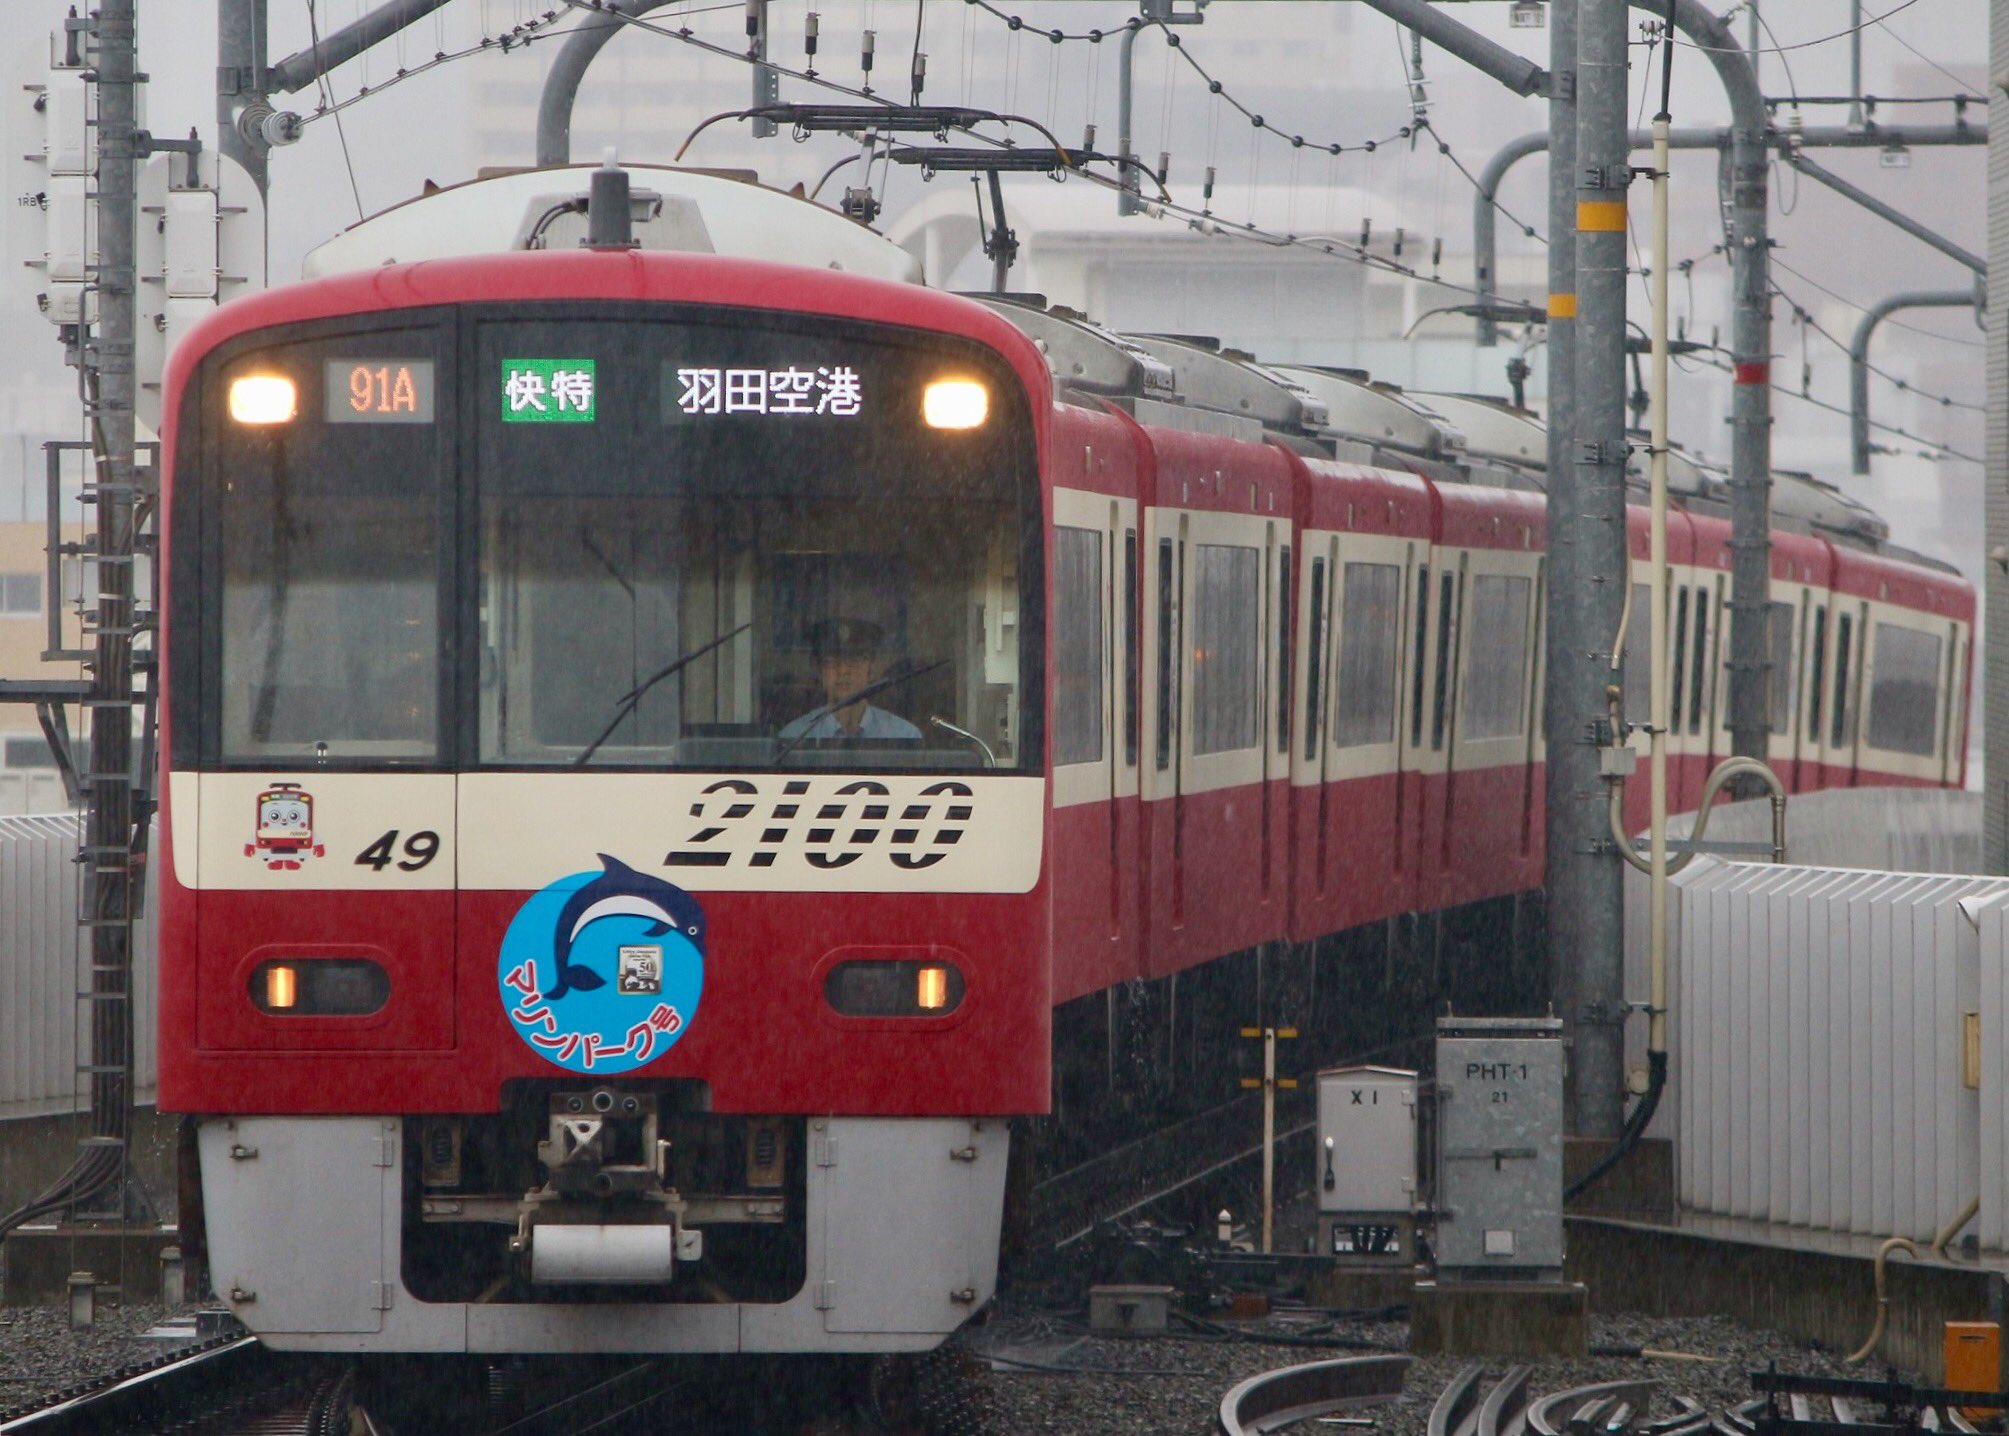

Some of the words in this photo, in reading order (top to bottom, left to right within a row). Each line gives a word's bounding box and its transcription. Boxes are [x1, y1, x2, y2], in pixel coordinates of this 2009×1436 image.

[350, 367, 417, 413] 91A
[505, 369, 593, 411] 快特
[677, 366, 862, 416] 羽田空港
[663, 779, 973, 870] 2100
[354, 829, 440, 872] 49
[505, 960, 682, 1068] マリンパーク号
[1491, 1091, 1508, 1103] 21
